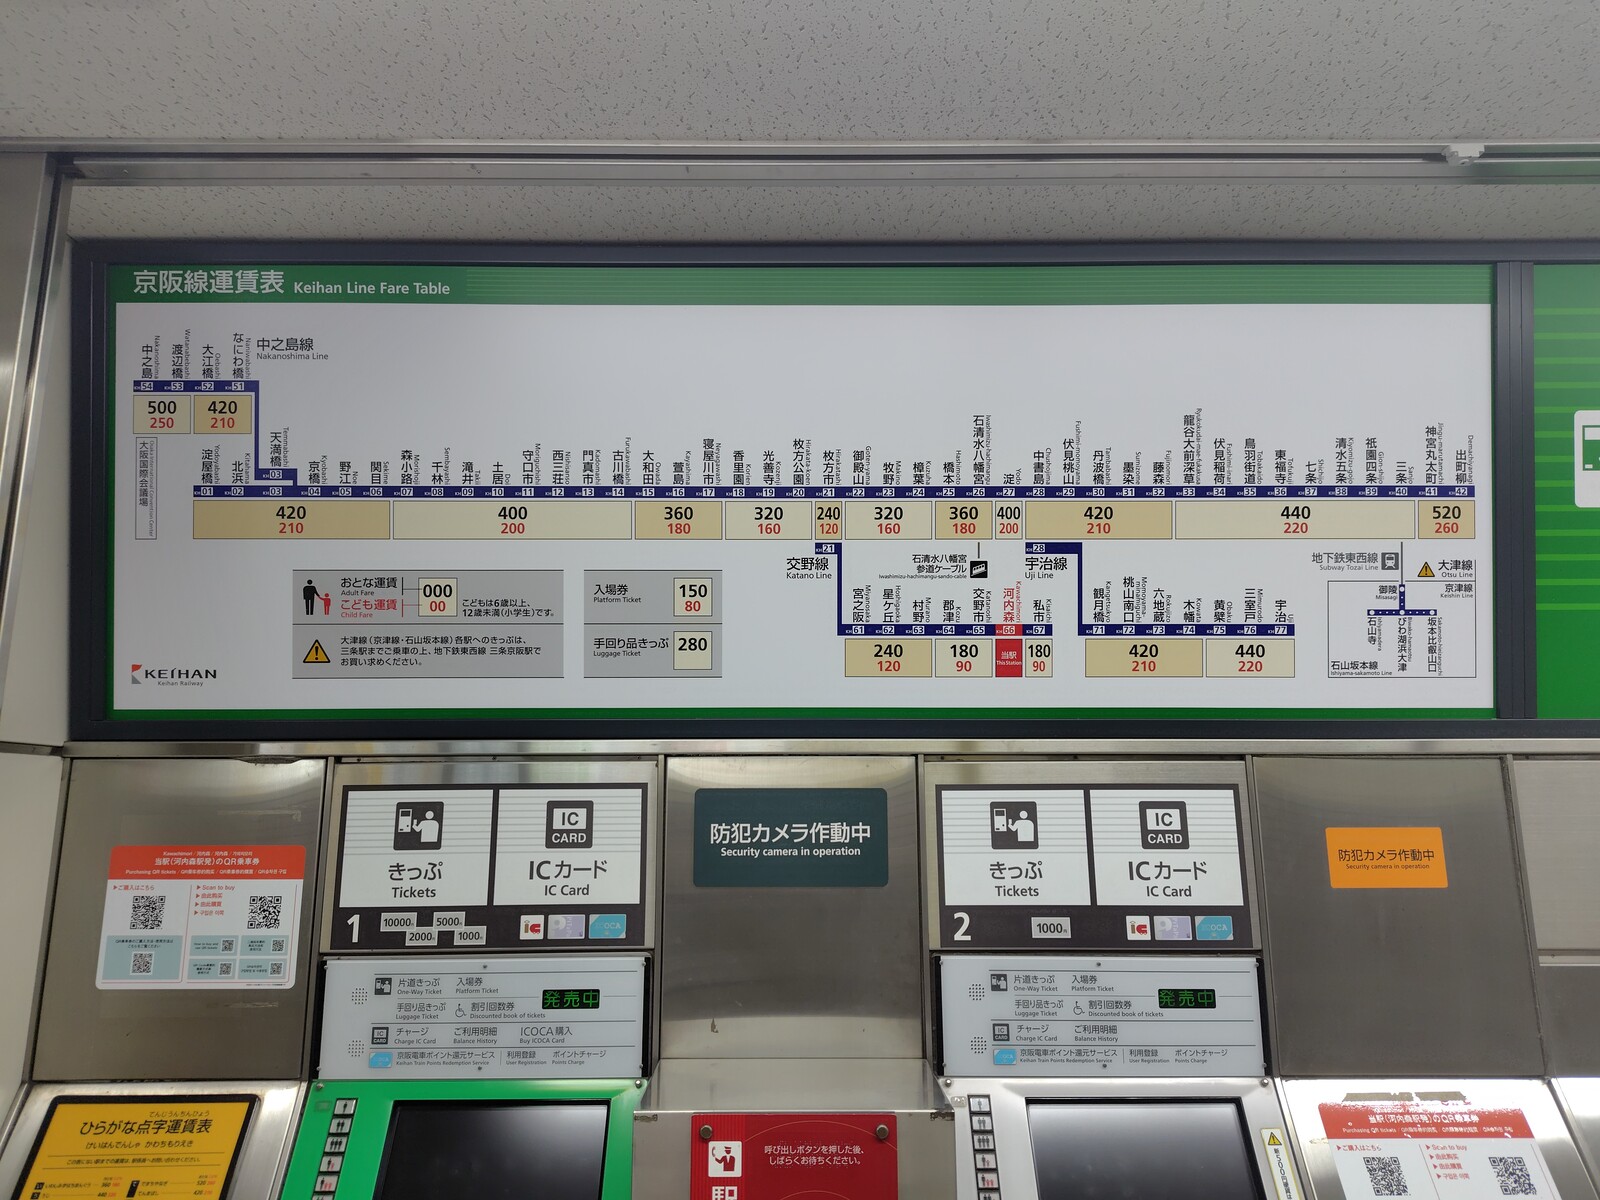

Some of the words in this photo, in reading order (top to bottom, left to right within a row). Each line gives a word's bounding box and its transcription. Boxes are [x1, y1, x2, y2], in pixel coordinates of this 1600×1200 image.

[134, 270, 284, 293] 京阪線運賃表
[294, 282, 341, 293] Keihan
[347, 282, 375, 293] Line
[381, 283, 409, 294] Fare
[413, 282, 450, 294] Table
[257, 338, 313, 351] 中之島線
[142, 344, 153, 379] 中之島
[172, 344, 183, 379] 渡辺橋
[202, 344, 213, 379] 大江橋
[233, 333, 244, 379] なにわ橋
[148, 401, 176, 414] 500
[208, 401, 237, 414] 420
[150, 418, 174, 428] 250
[211, 418, 234, 428] 210
[270, 432, 282, 467] 天満橋
[973, 415, 984, 484] 石清水八幡宮
[1183, 415, 1195, 484] 龍谷大前深草
[1425, 426, 1438, 486] 神宮丸太町
[200, 449, 214, 485] 淀屋橋
[522, 450, 535, 484] 守口市
[643, 450, 654, 484] 大和田
[793, 439, 804, 485] 枚方公園
[823, 450, 834, 485] 枚方市
[1033, 450, 1044, 485] 中書島
[1063, 439, 1074, 484] 伏見桃山
[1093, 451, 1104, 485] 丹波橋
[1275, 450, 1286, 484] 東福寺
[1455, 450, 1468, 485] 出町柳
[231, 461, 244, 485] 北浜
[308, 460, 321, 485] 京橋
[943, 462, 954, 484] 橋本
[1003, 474, 1014, 484] 淀
[1395, 462, 1408, 485] 三条
[276, 506, 306, 519] 420
[498, 507, 527, 519] 400
[664, 507, 693, 520] 360
[755, 507, 783, 520] 320
[817, 507, 840, 520] 240
[1281, 506, 1310, 519] 440
[1433, 506, 1461, 519] 520
[279, 523, 303, 533] 210
[668, 523, 690, 534] 180
[758, 523, 780, 534] 160
[820, 523, 838, 534] 120
[1284, 523, 1308, 533] 220
[787, 557, 829, 570] 交野線
[912, 554, 967, 563] 石清水八幡宮
[1025, 557, 1067, 570] 宇治線
[1312, 552, 1378, 563] 地下鉄東西線
[917, 564, 967, 573] 参道ケーブル
[1438, 560, 1472, 571] 大津線
[341, 577, 397, 588] おとな運賃
[1025, 572, 1035, 580] Uji
[423, 584, 452, 597] 000
[594, 584, 628, 595] 入場券
[679, 584, 707, 597] 150
[341, 599, 397, 610] こども運賃
[430, 601, 445, 612] 00
[685, 601, 700, 611] 80
[853, 588, 865, 622] 宮之阪
[973, 588, 984, 622] 交野市
[1003, 588, 1014, 622] 河内森
[1033, 600, 1044, 622] 私市
[1153, 588, 1166, 622] 六地蔵
[1275, 600, 1286, 622] 宇治
[594, 638, 669, 649] 手回り品きっぷ
[678, 638, 707, 651] 280
[1398, 617, 1407, 671] びわ湖浜大津
[874, 644, 903, 657] 240
[950, 644, 978, 657] 180
[1001, 651, 1016, 659] 当駅
[1129, 644, 1158, 657] 420
[1235, 645, 1265, 657] 440
[878, 661, 900, 671] 120
[956, 661, 971, 671] 90
[1238, 661, 1262, 672] 220
[1331, 661, 1378, 670] 石山坂本線
[145, 668, 216, 678] KEIHAN
[562, 812, 578, 825] IC
[1155, 813, 1172, 826] IC
[552, 833, 586, 843] CARD
[711, 822, 870, 844] 防犯カメラ作動中
[1148, 834, 1182, 843] CARD
[721, 847, 760, 858] Security
[801, 847, 810, 855] in
[813, 846, 860, 857] operation
[1338, 849, 1434, 861] 防犯カメラ作動中
[389, 862, 443, 880] きっぷ
[529, 860, 607, 880] ICカード
[990, 861, 1042, 879] きっぷ
[1129, 861, 1207, 880] ICカード
[392, 886, 436, 898] Tickets
[545, 885, 556, 896] IC
[561, 884, 589, 895] Card
[995, 885, 1039, 896] Tickets
[1147, 886, 1159, 897] IC
[1163, 885, 1191, 897] Card
[347, 915, 360, 942] 1
[954, 912, 971, 940] 2
[398, 978, 440, 987] 片道きっぷ
[457, 977, 482, 986] 入場券
[544, 990, 599, 1007] 発売中
[1015, 1000, 1063, 1009] 手回り品きっぷ
[1159, 990, 1215, 1007] 発売中
[471, 1002, 514, 1011] 割引回数券
[454, 1027, 497, 1036] ご利用明細
[1017, 1025, 1049, 1033] チャージ
[397, 1051, 495, 1059] 京阪電車ポイント還元サービス
[1130, 1049, 1158, 1057] 利用登録
[80, 1119, 213, 1135] ひらがな点字運賃表
[765, 1145, 863, 1155] 呼び出しボタンを押した後、
[770, 1156, 860, 1165] しばらくお待ちください。
